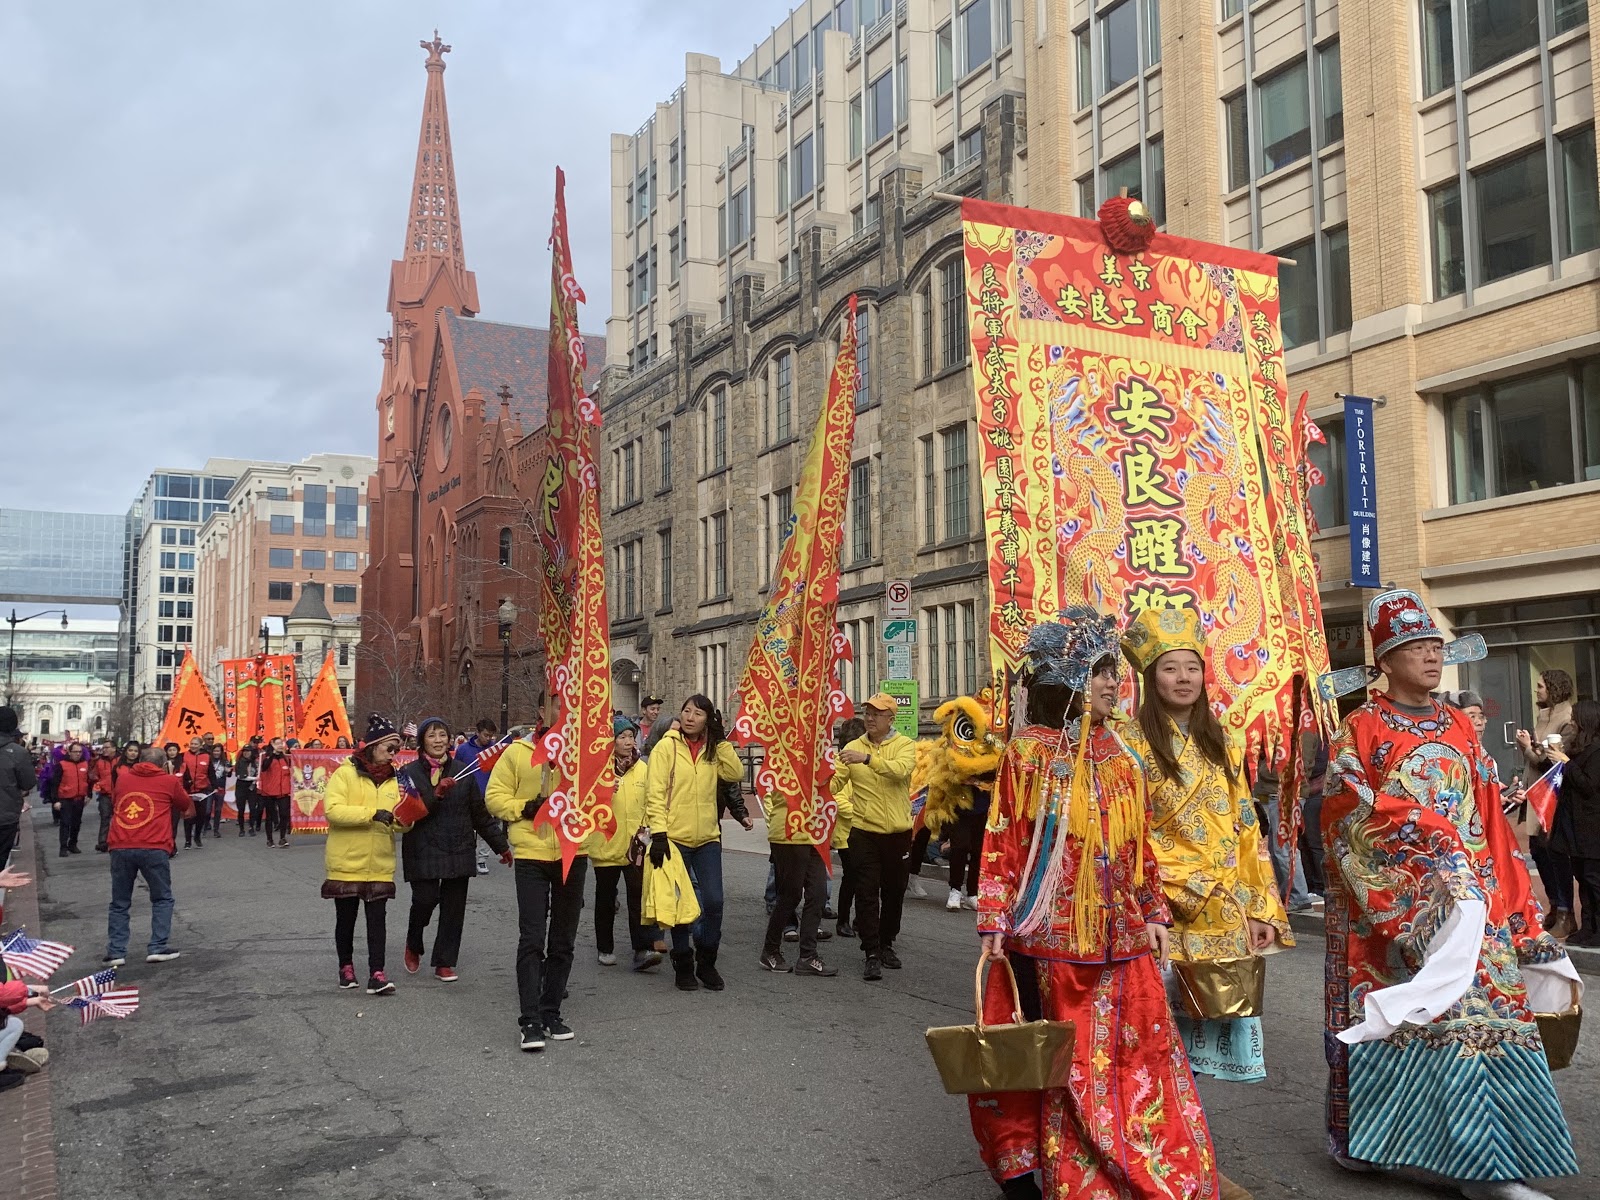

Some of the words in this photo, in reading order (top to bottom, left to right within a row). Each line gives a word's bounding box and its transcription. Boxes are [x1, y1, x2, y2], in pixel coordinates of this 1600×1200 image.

[1099, 254, 1152, 293] 美京
[1056, 283, 1208, 341] 安良工商會
[1353, 408, 1365, 416] THE
[1356, 416, 1370, 509] PORTRAIT
[1352, 510, 1376, 519] BUILDING
[1360, 522, 1372, 576] 肖像建筑
[893, 697, 911, 705] 041
